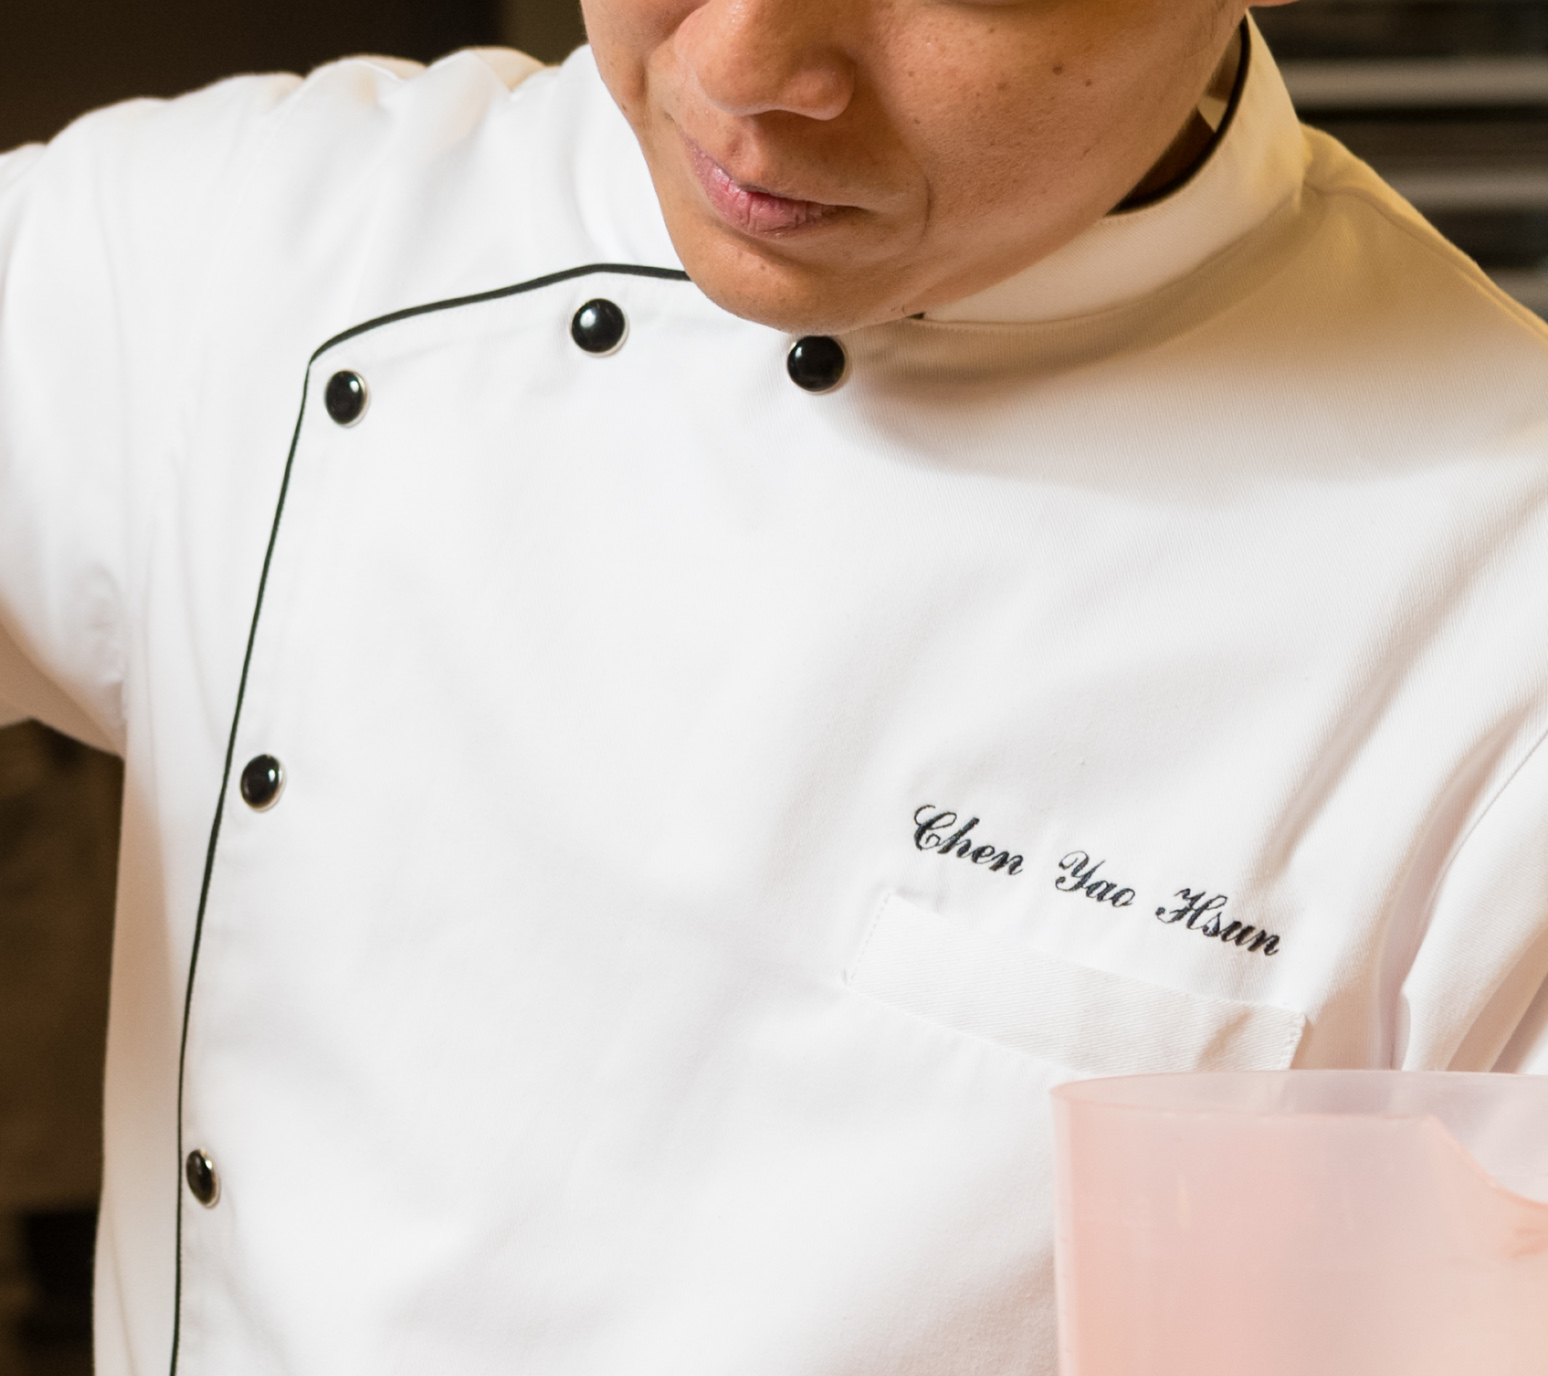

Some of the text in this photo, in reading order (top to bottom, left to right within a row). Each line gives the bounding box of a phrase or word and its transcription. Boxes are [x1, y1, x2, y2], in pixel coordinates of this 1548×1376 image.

[913, 804, 1280, 956] Chen Yao Hsun
